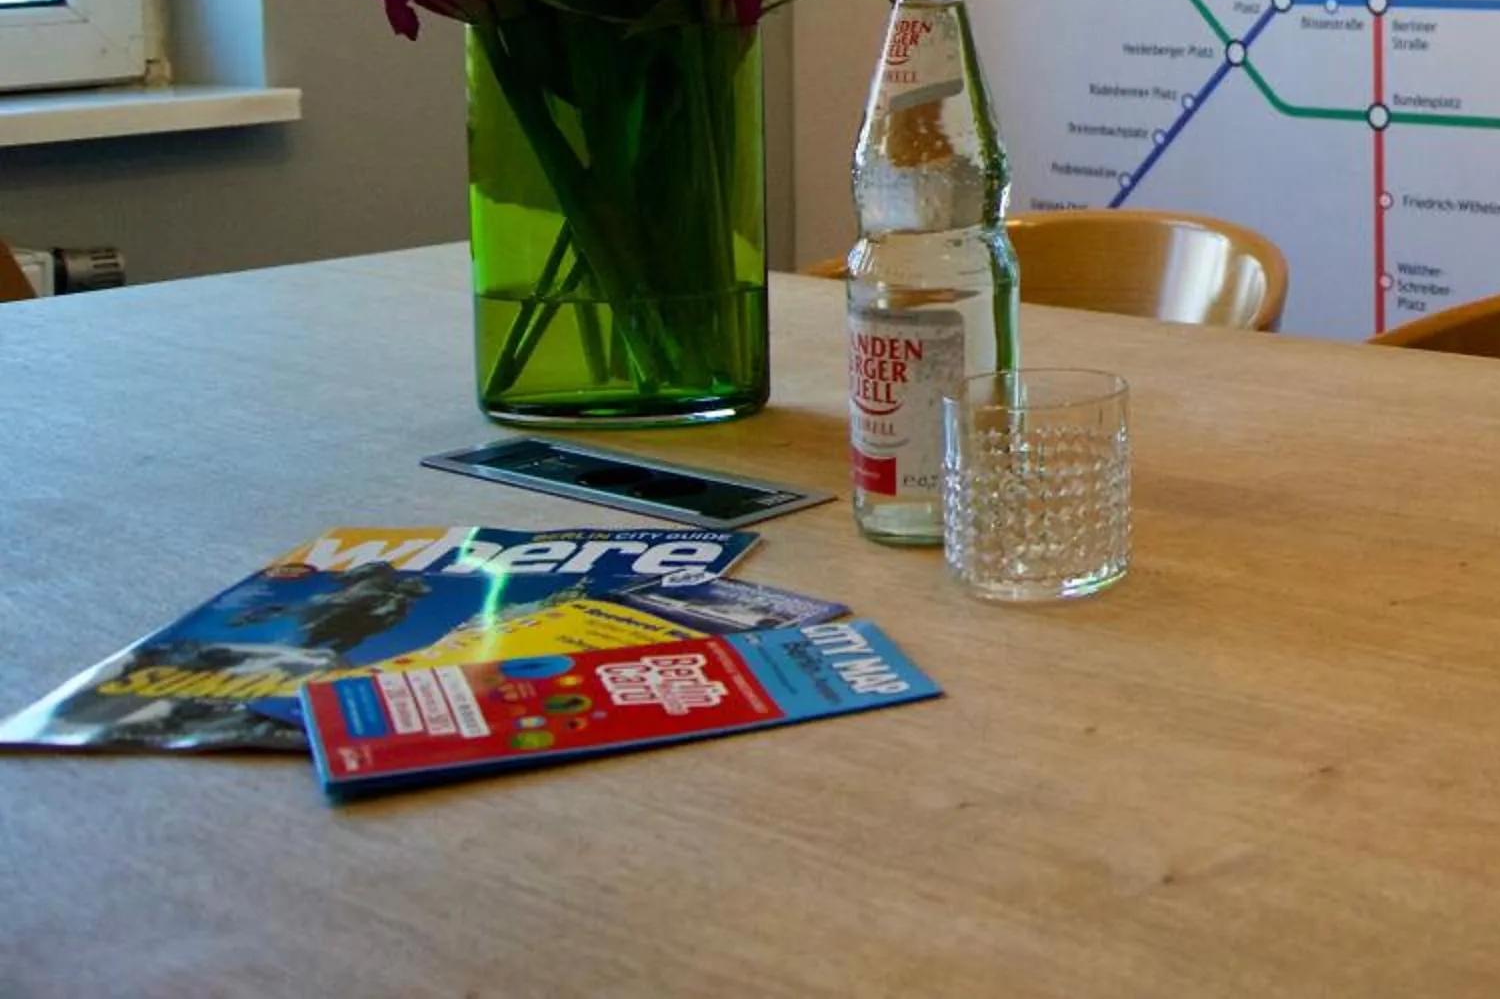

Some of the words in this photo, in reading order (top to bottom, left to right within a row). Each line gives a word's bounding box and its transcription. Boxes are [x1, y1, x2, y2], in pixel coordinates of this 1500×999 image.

[304, 526, 723, 575] where
[533, 532, 609, 543] BERLIN
[614, 531, 660, 542] CITY
[666, 531, 732, 542] GUIDE
[801, 622, 874, 655] CITY
[831, 656, 910, 694] MAP
